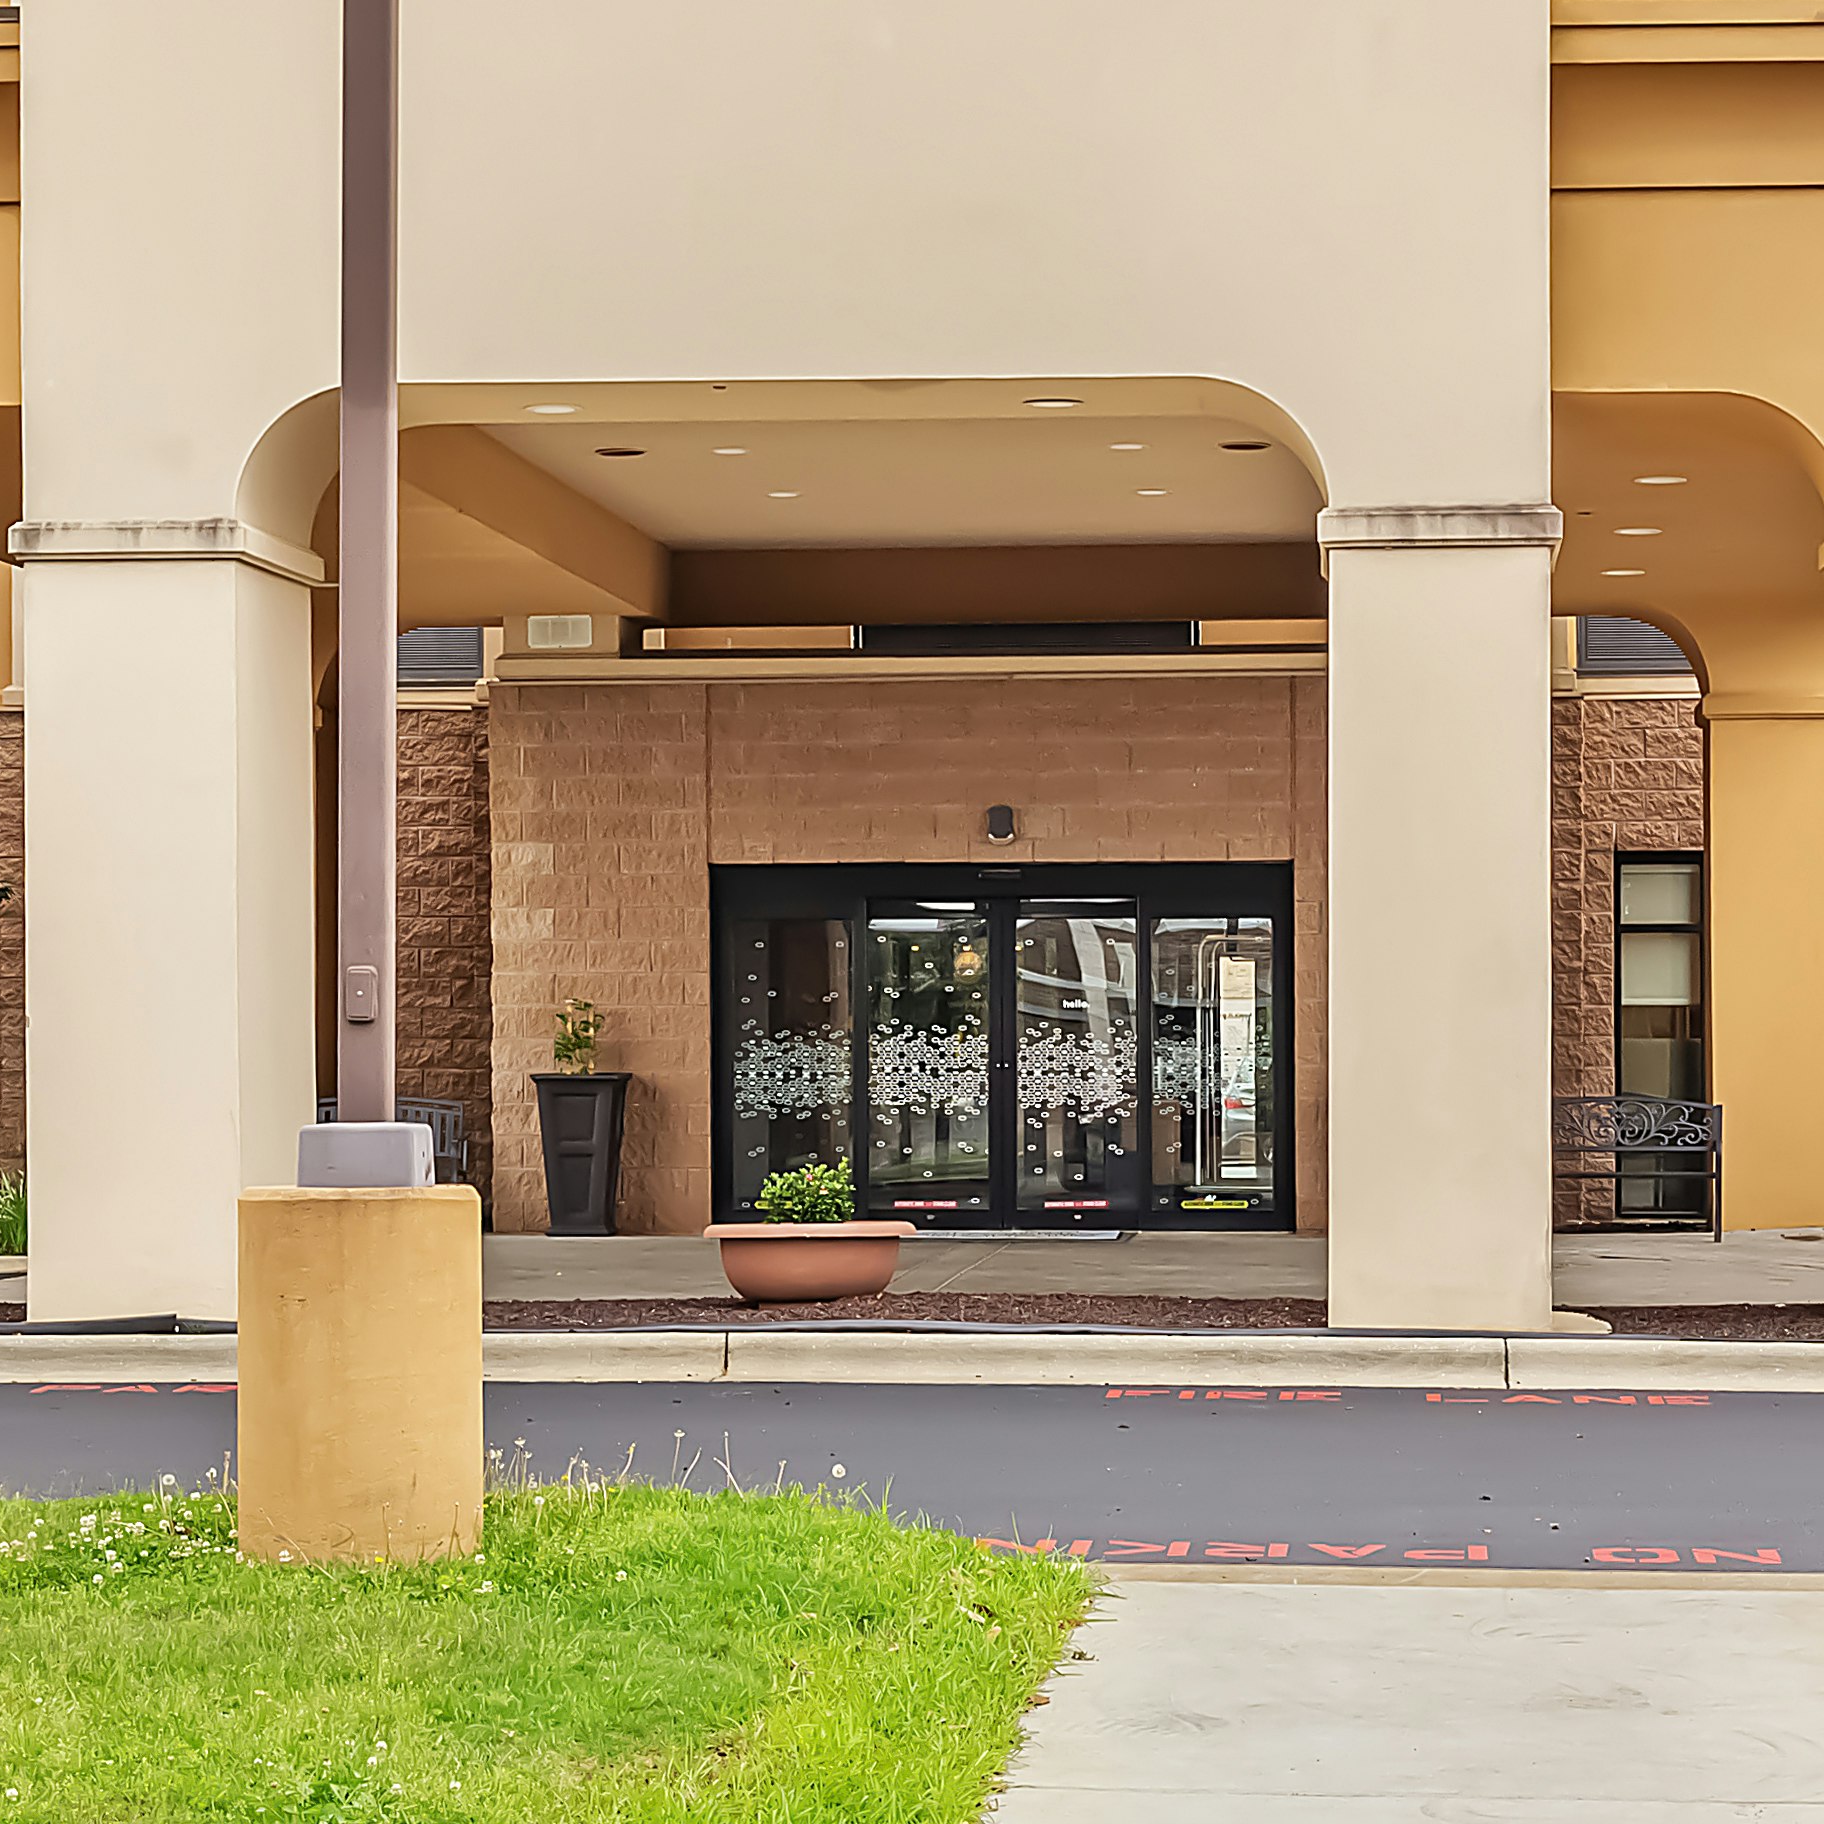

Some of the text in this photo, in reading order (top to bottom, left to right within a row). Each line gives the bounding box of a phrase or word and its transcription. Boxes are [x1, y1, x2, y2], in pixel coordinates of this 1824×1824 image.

[29, 1384, 238, 1394] PAR
[1105, 1388, 1713, 1406] FIRE LANE
[977, 1537, 1784, 1566] NO PARKIN
